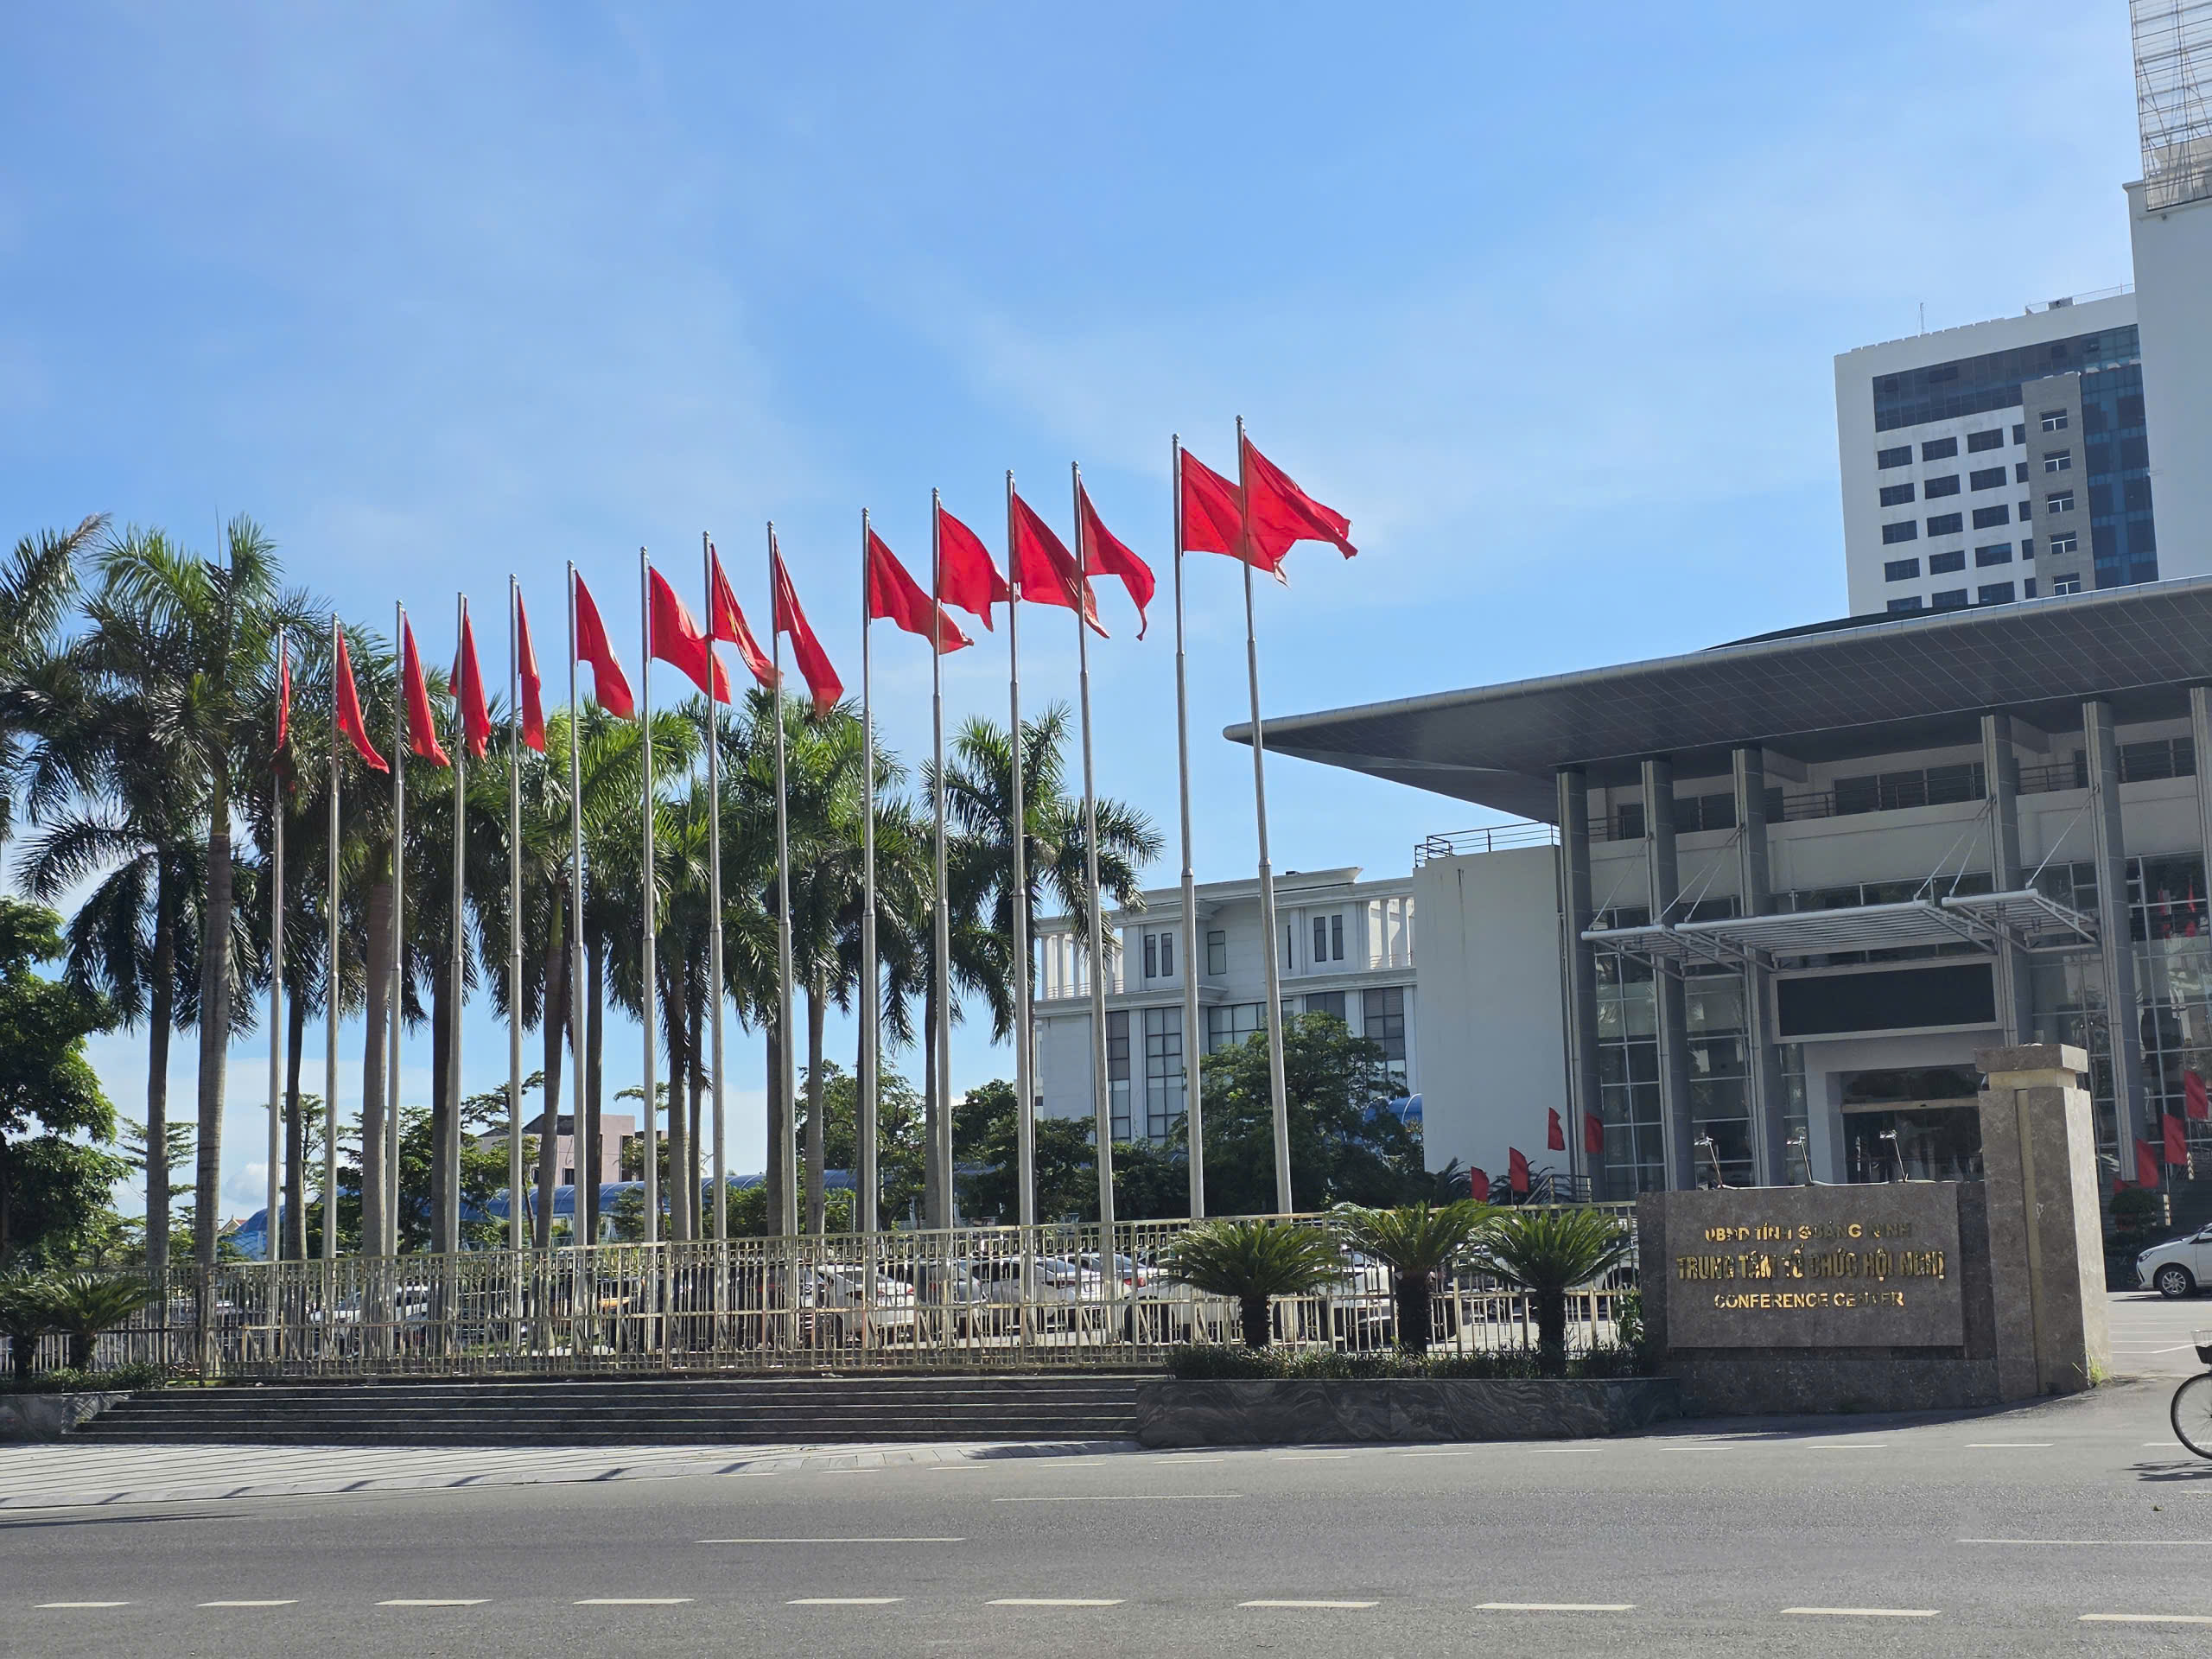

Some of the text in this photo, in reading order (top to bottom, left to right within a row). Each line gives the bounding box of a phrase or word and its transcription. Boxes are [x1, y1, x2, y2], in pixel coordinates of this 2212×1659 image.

[1676, 1255, 1734, 1280] TRUNG
[1738, 1250, 1777, 1279] TÂM
[1862, 1245, 1894, 1281] HỘI
[1714, 1291, 1904, 1309] CONFERENCE CENTER
